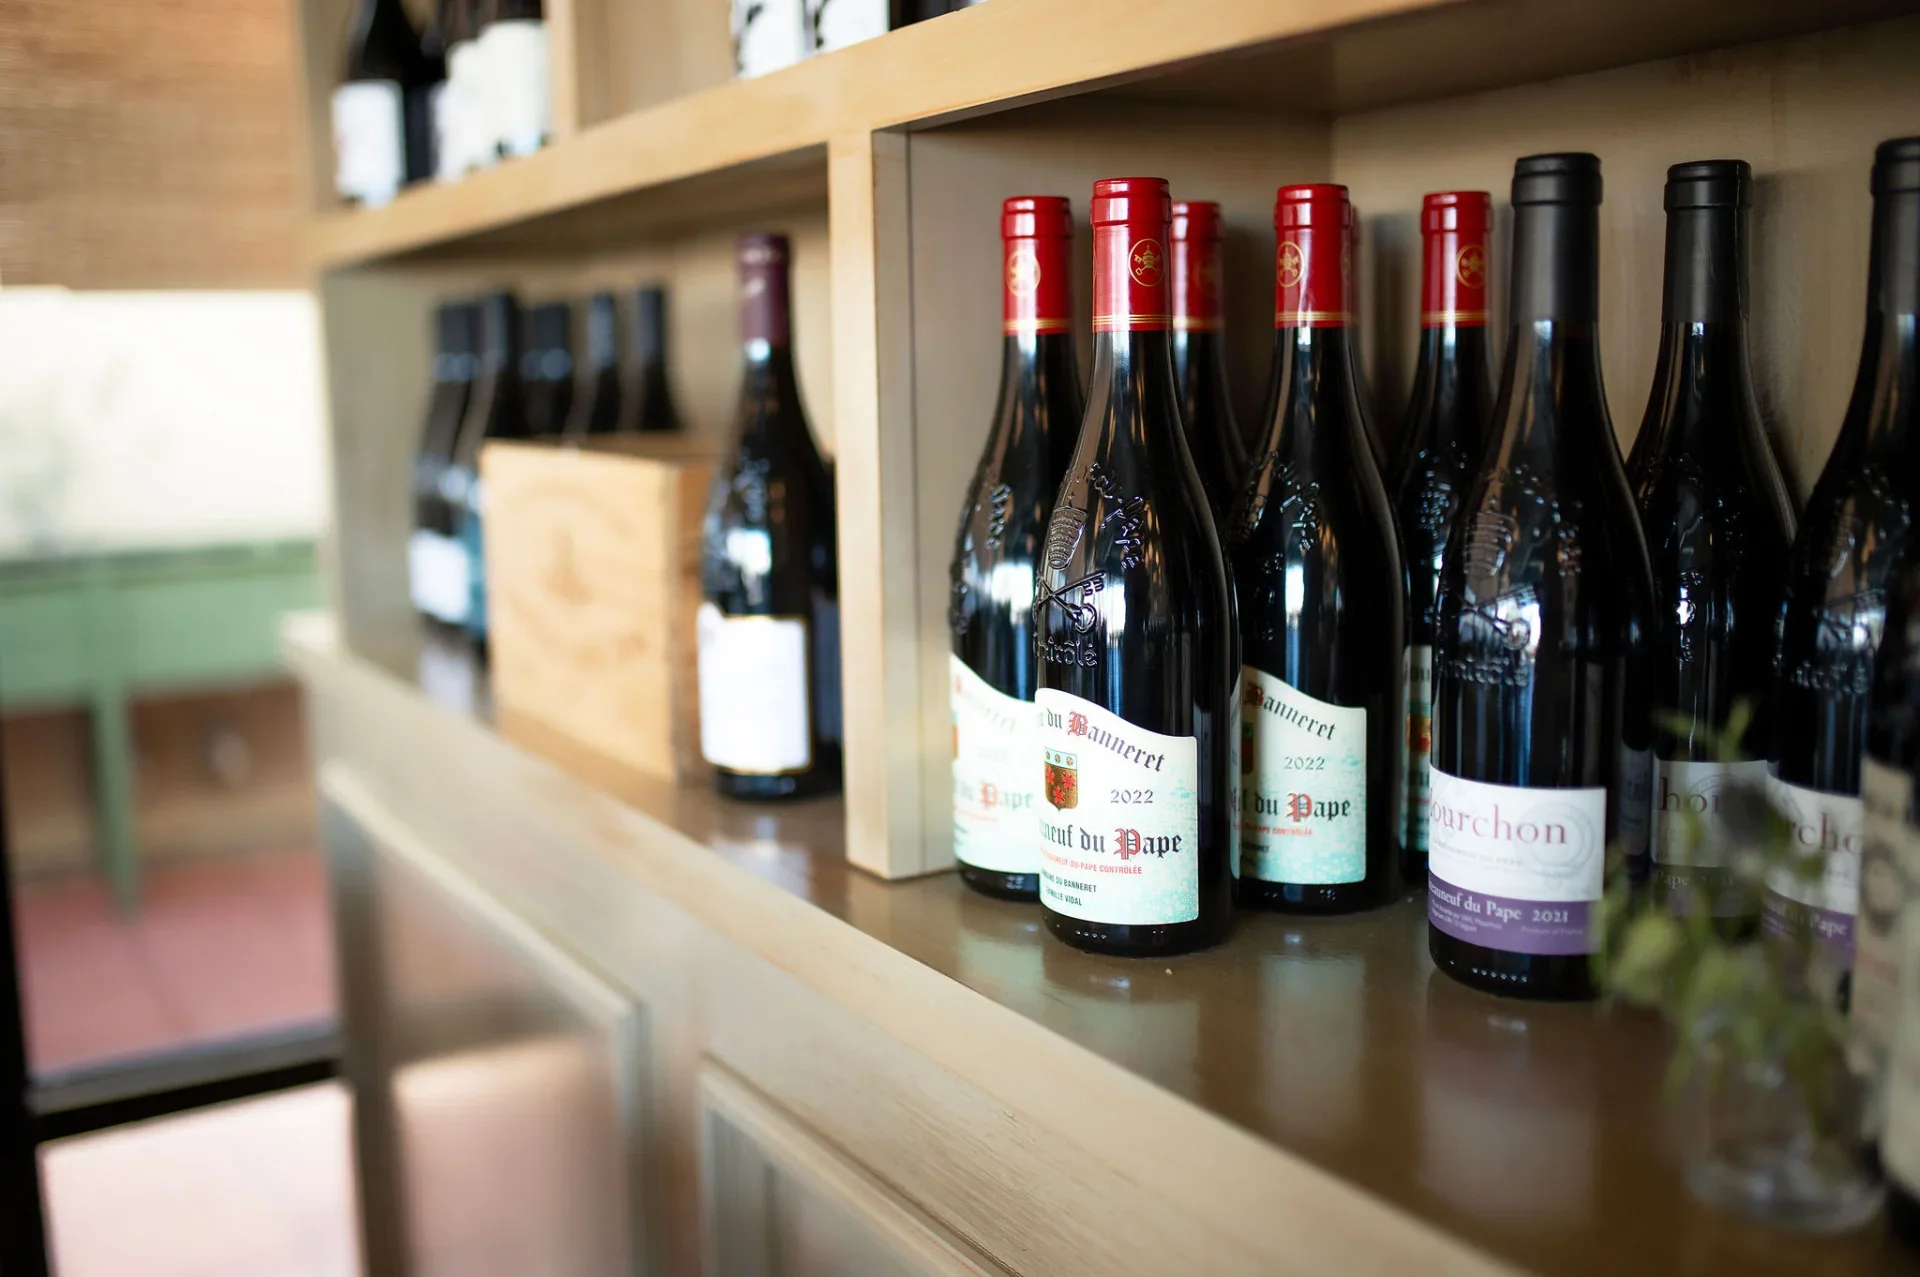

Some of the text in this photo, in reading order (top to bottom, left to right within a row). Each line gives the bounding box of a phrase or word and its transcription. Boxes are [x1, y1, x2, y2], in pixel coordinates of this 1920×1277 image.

[1246, 682, 1336, 740] Banneret
[1046, 707, 1165, 772] du Banneret
[1284, 756, 1325, 770] 2022
[1110, 788, 1154, 804] 2022
[1254, 791, 1278, 815] du
[1286, 792, 1351, 823] Pape
[1079, 826, 1107, 854] du
[1112, 827, 1183, 860] Pape
[1099, 864, 1143, 875] CONTRÔLÉE
[1063, 878, 1097, 892] BANNERET
[1064, 894, 1083, 906] VIDAL
[1464, 895, 1481, 913] du
[1486, 900, 1522, 923] Pape
[1532, 909, 1569, 923] 2021
